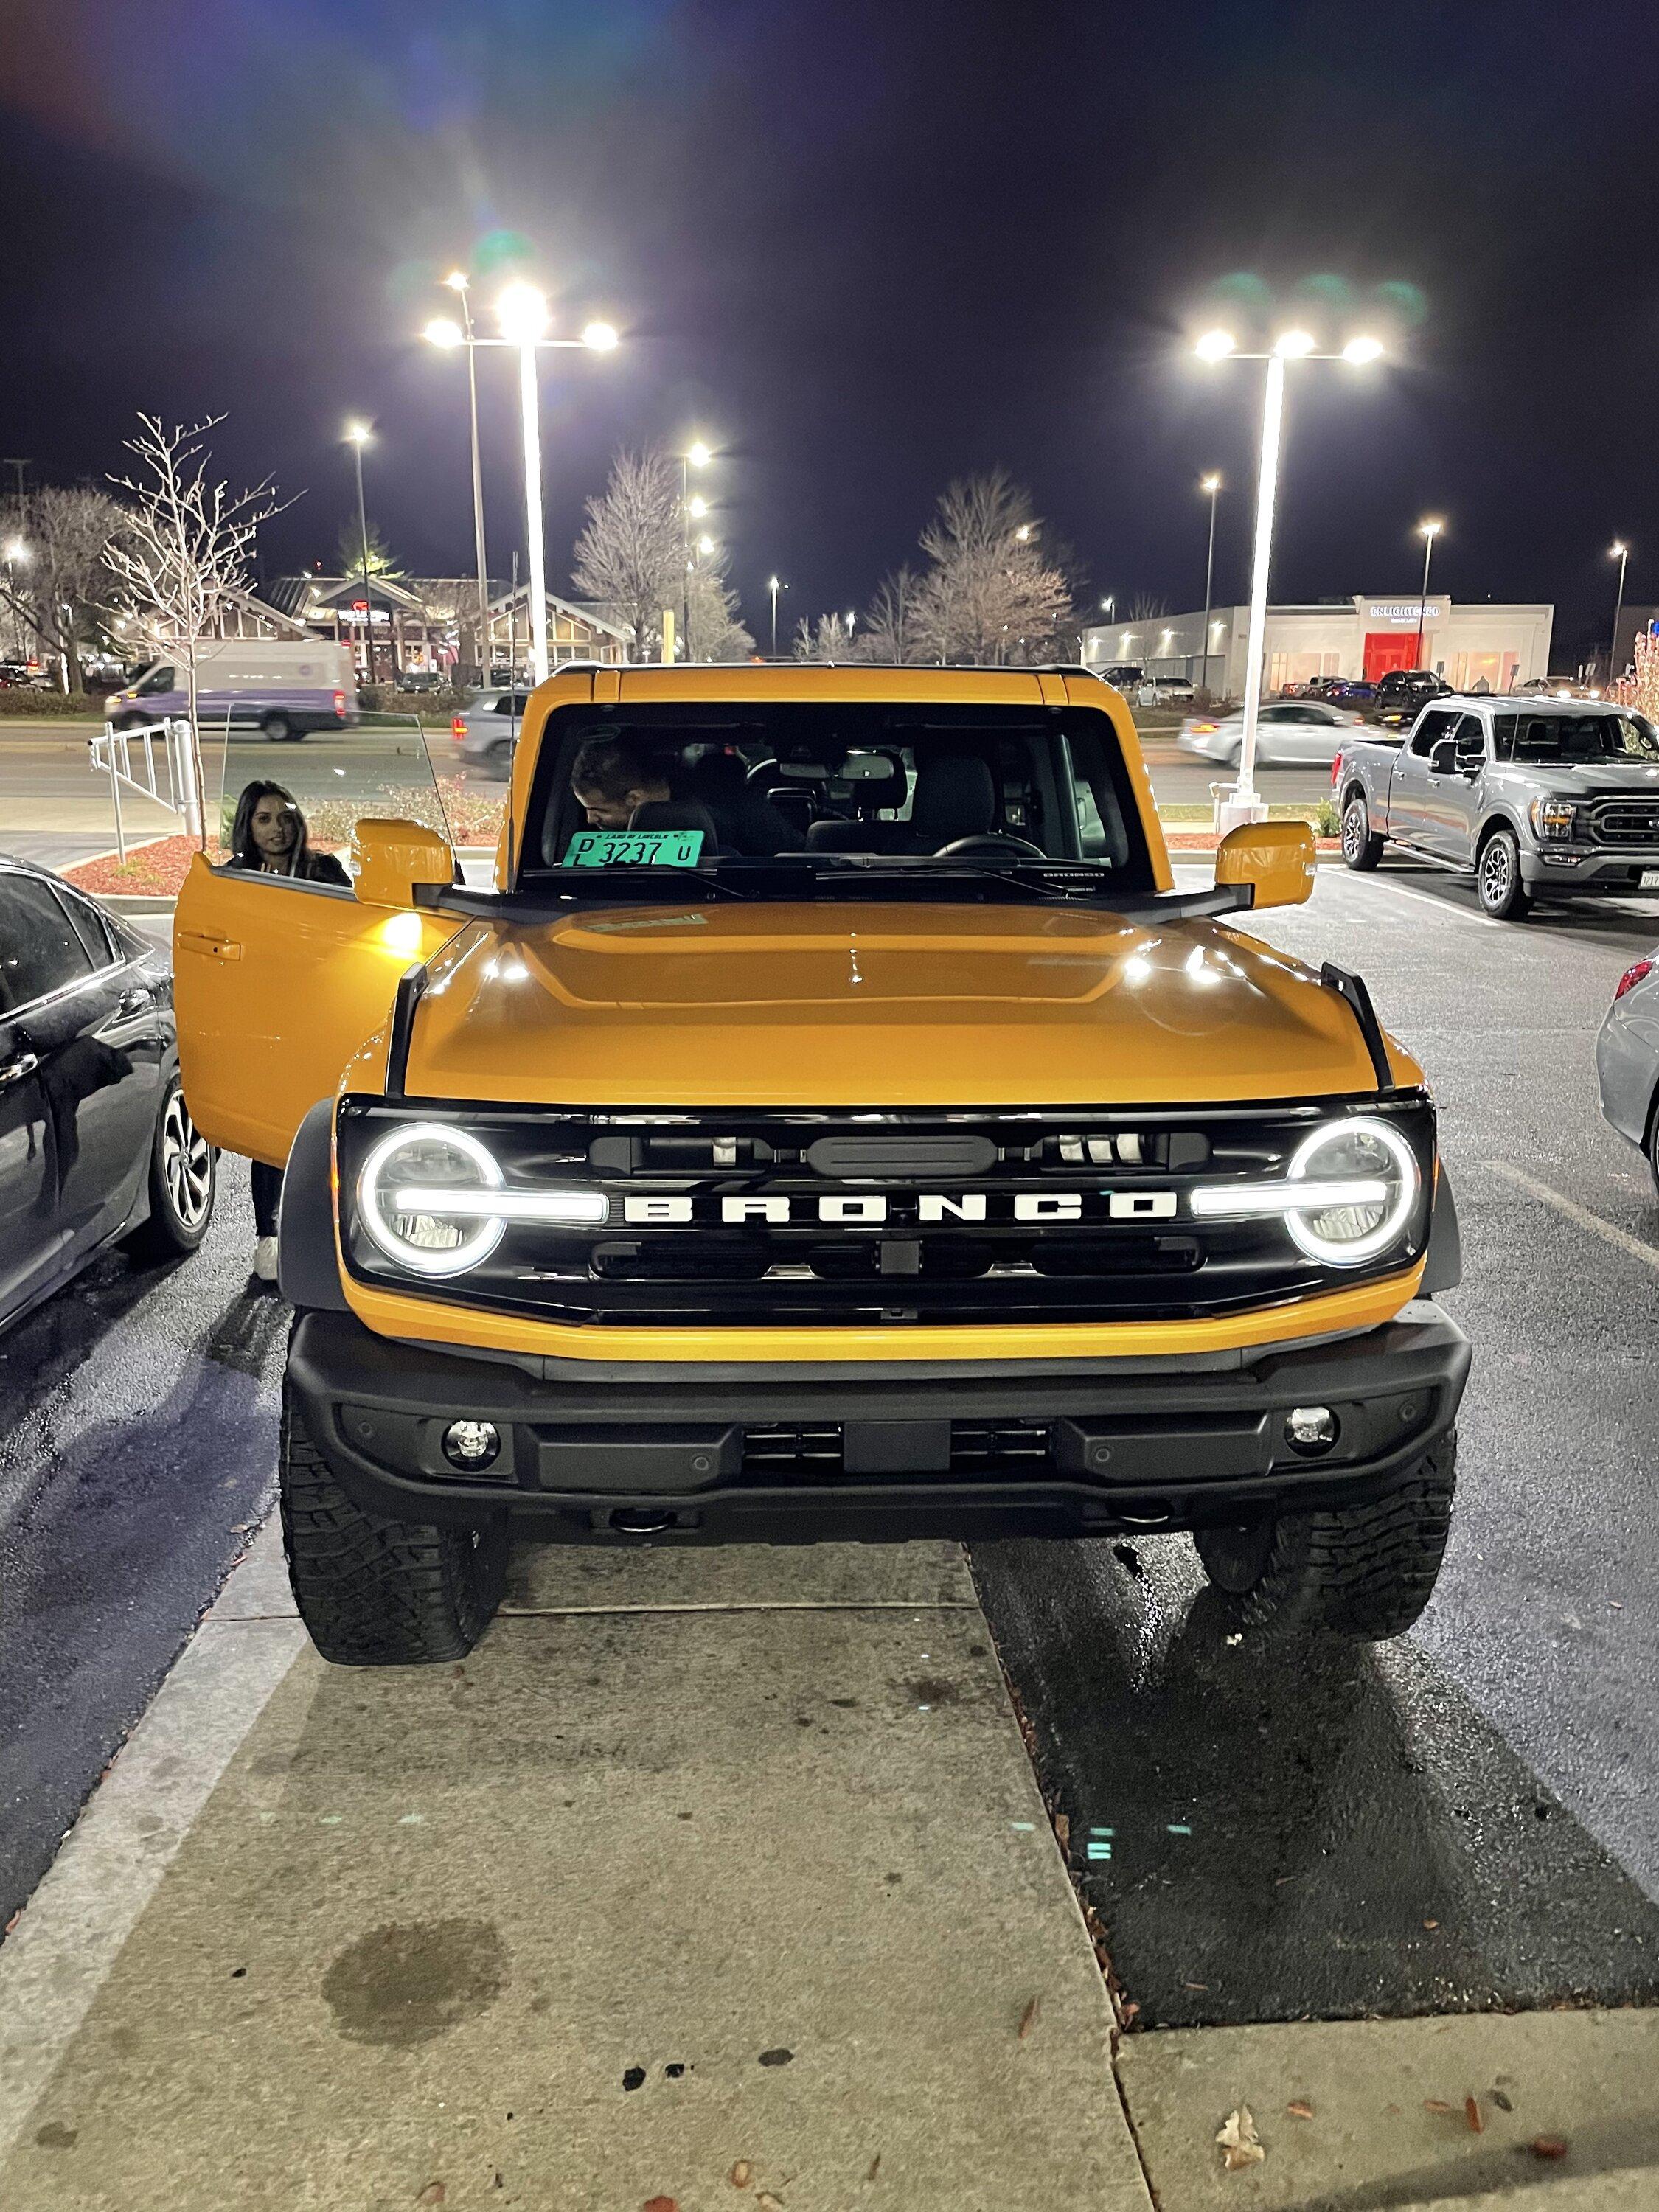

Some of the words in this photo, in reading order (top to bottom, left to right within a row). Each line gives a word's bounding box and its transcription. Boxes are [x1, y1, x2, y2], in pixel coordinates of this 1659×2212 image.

[599, 842, 662, 865] 3237
[677, 846, 691, 861] U
[624, 1192, 1178, 1222] BRONCO
